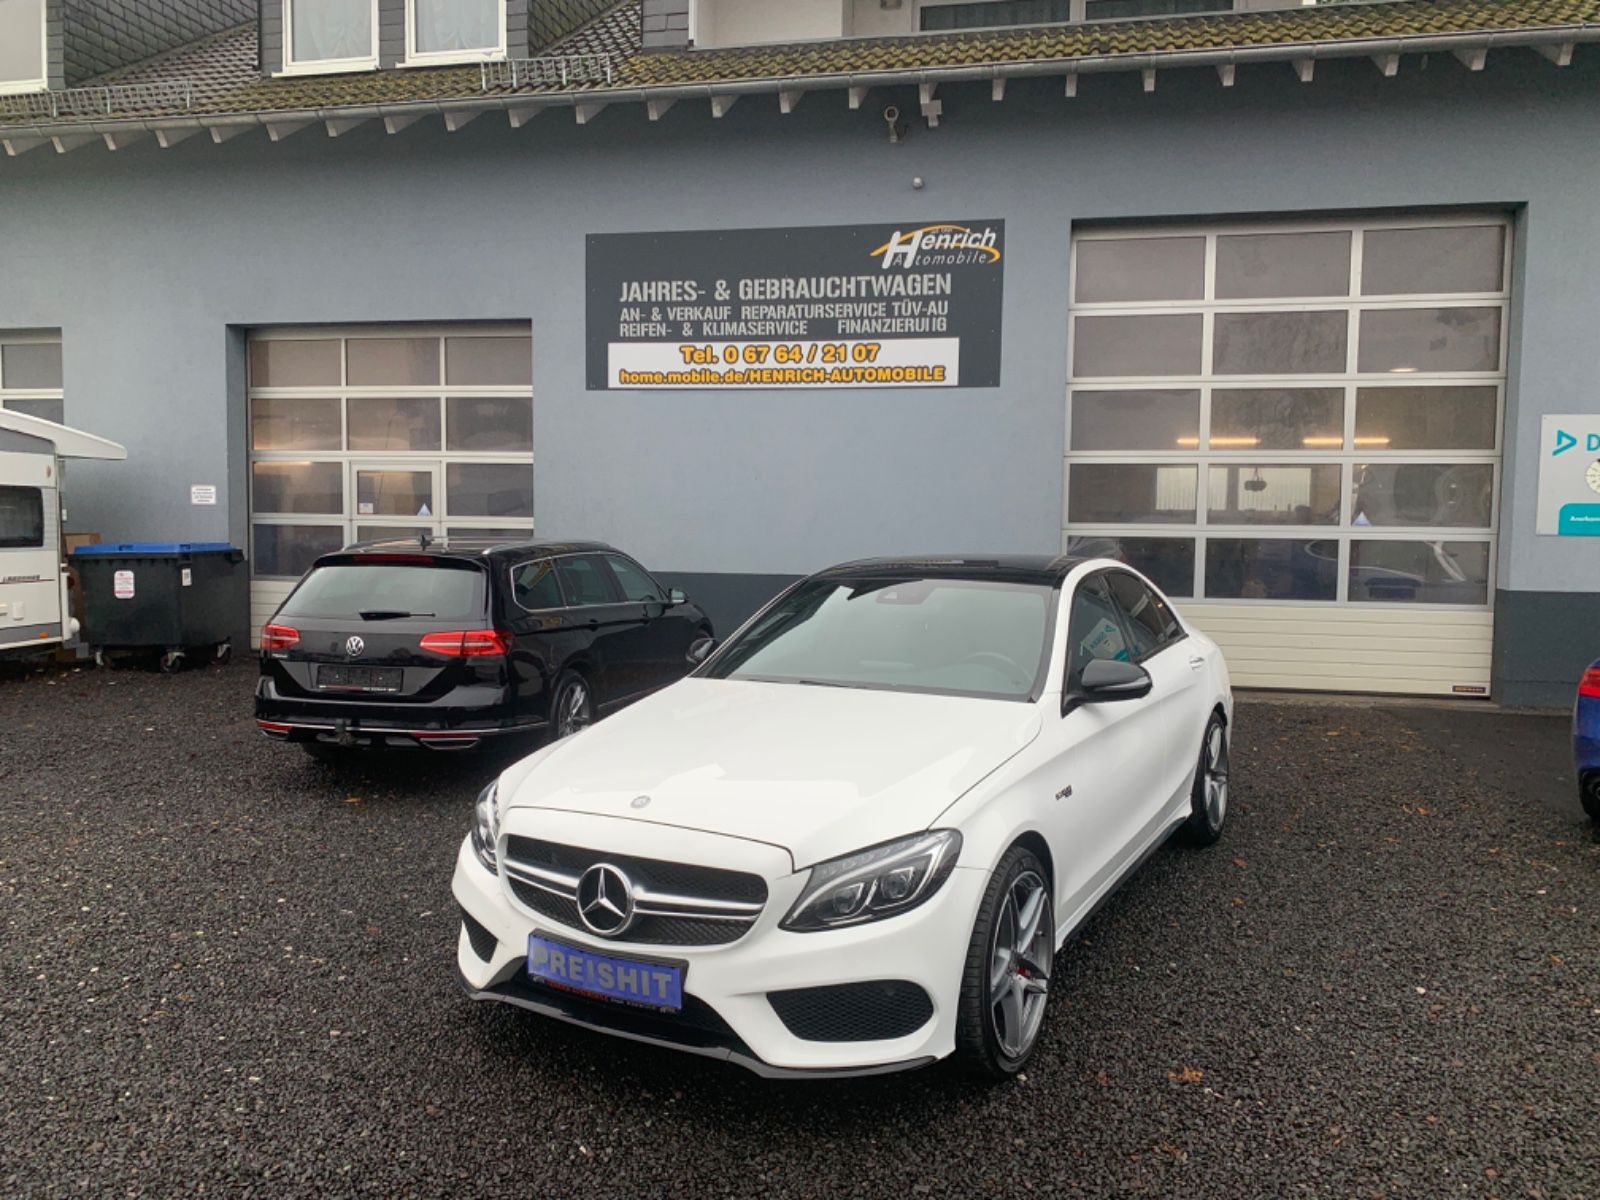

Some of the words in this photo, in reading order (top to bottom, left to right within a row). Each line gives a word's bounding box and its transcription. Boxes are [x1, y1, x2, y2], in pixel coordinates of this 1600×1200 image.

[882, 227, 996, 270] Henrich
[893, 251, 987, 266] Atomobile
[620, 280, 706, 302] JAHRES-
[714, 279, 731, 301] &
[739, 273, 952, 300] GEBRAUCHTWAGEN
[620, 307, 646, 322] AN-
[651, 307, 663, 321] &
[667, 305, 732, 321] VERKAUF
[741, 301, 886, 320] REPARATURSERVICE
[892, 299, 948, 317] TÜV-AU
[620, 322, 672, 337] REIFEN-
[682, 322, 693, 336] &
[703, 320, 808, 336] KLIMASERVICE
[679, 344, 720, 364] Tel.
[723, 345, 739, 364] 0
[743, 344, 770, 364] 67
[774, 344, 803, 363] 64
[806, 343, 818, 363] /
[821, 343, 847, 362] 21
[852, 342, 881, 362] 07
[619, 365, 946, 384] home.mobile.de/HENRICH-AUTOMOBILE
[531, 943, 673, 999] PREISHIT
